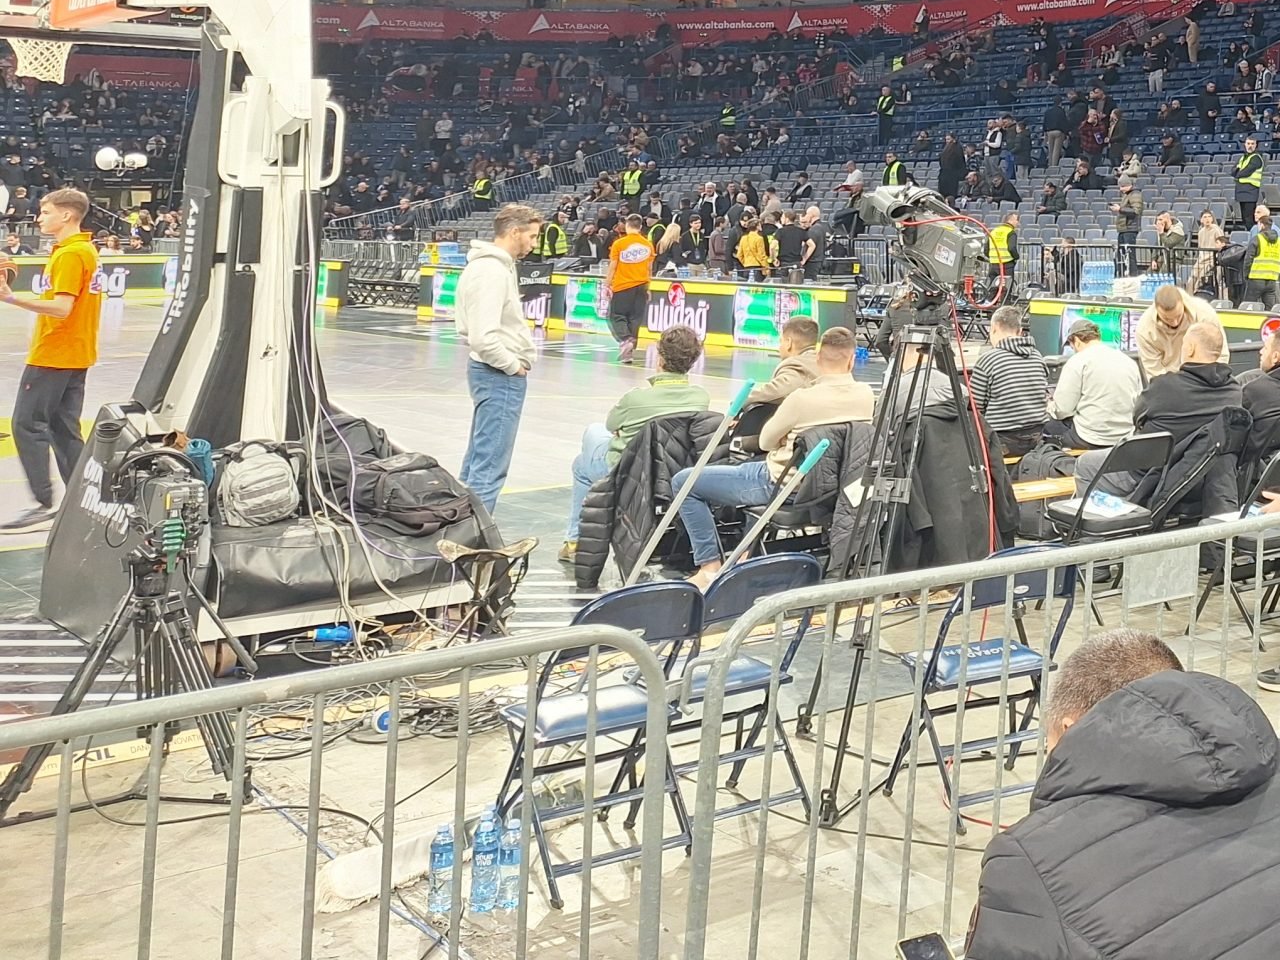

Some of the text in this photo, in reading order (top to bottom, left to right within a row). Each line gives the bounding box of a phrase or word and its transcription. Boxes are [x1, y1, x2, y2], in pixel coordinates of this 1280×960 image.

[380, 19, 445, 28] ALTABANKA
[550, 23, 610, 31] ALTABANKA
[676, 20, 775, 30] www.altabanka.com
[803, 18, 849, 27] ALTABANKA
